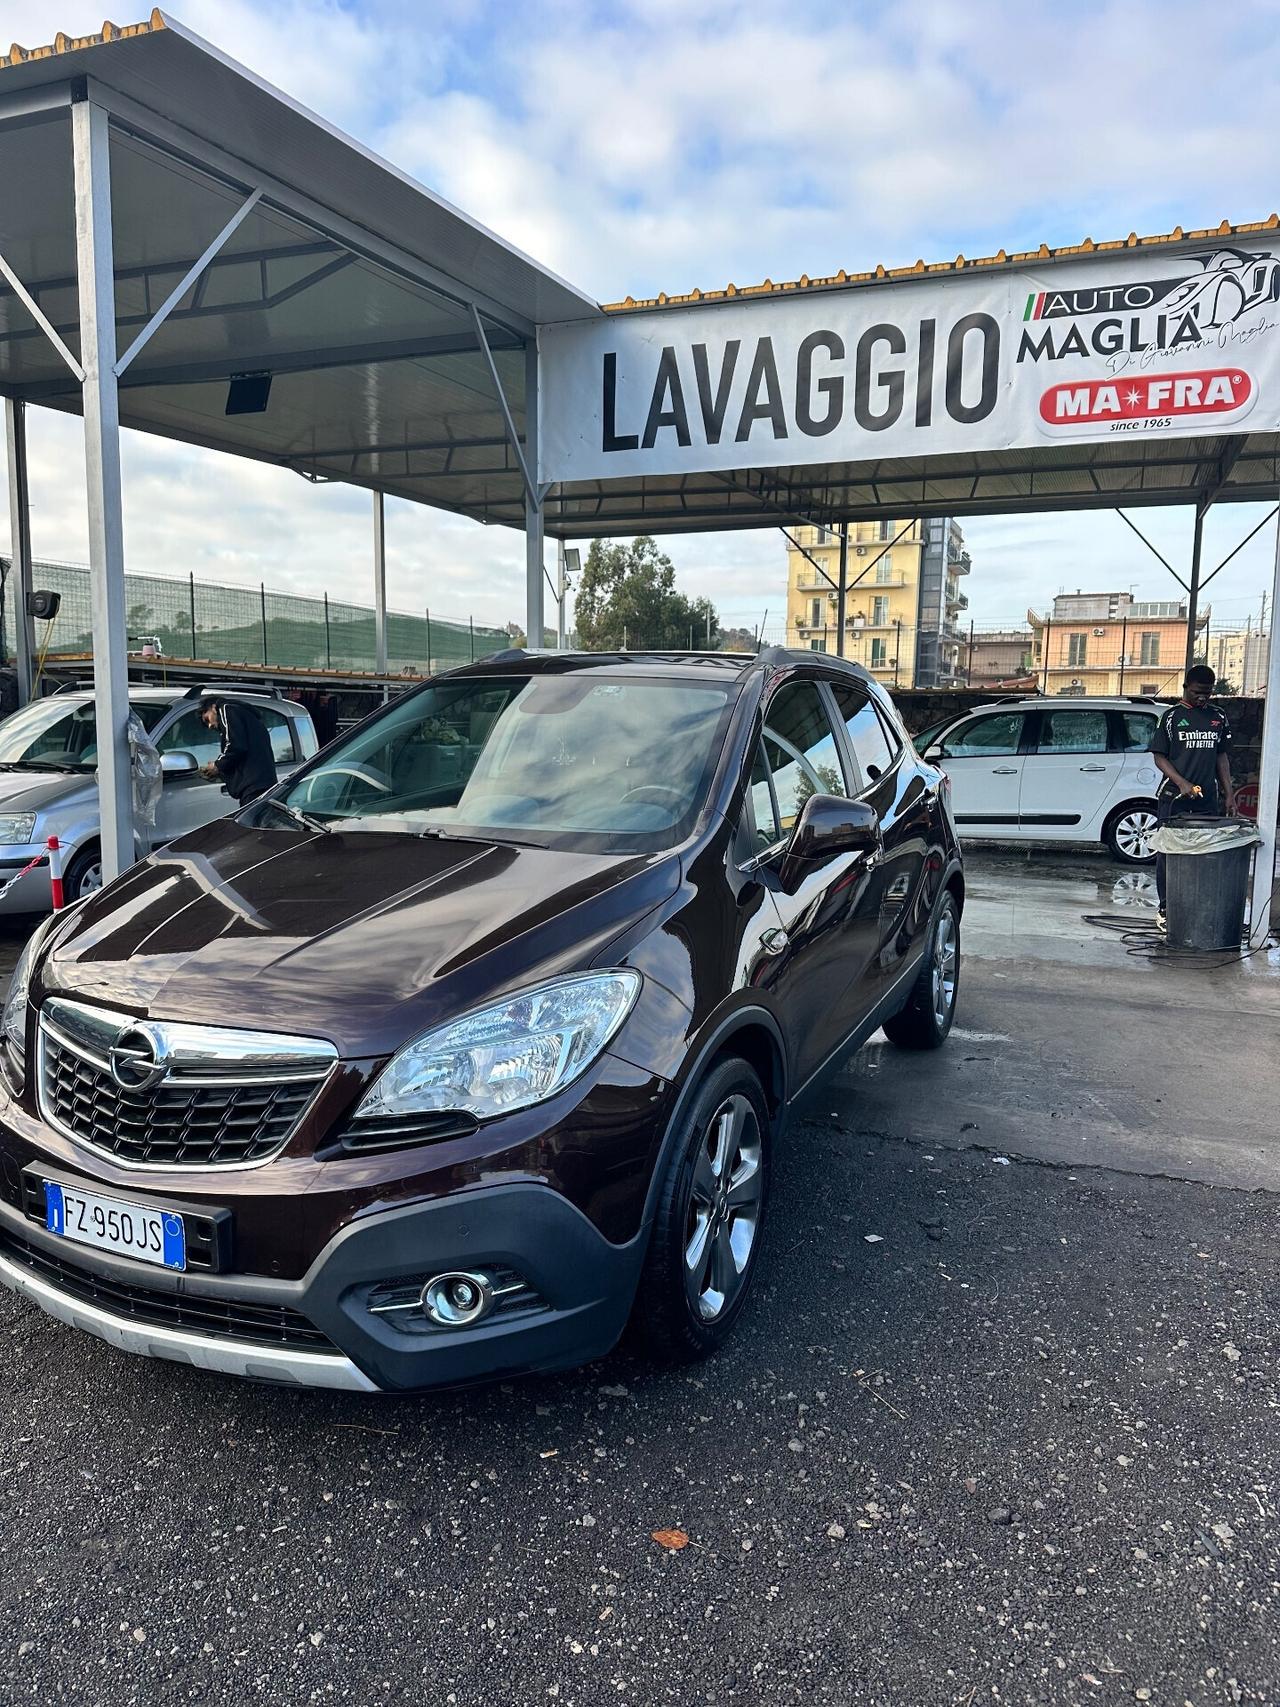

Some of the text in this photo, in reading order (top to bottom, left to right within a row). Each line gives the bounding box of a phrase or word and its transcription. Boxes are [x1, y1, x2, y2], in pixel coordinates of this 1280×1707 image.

[1043, 285, 1154, 316] AUTO
[1016, 311, 1203, 363] MAGLIA
[602, 312, 1001, 452] LAVAGGIO
[1110, 417, 1172, 431] since 1965
[1178, 730, 1218, 741] Emirates
[1186, 740, 1214, 748] FLY BETTER
